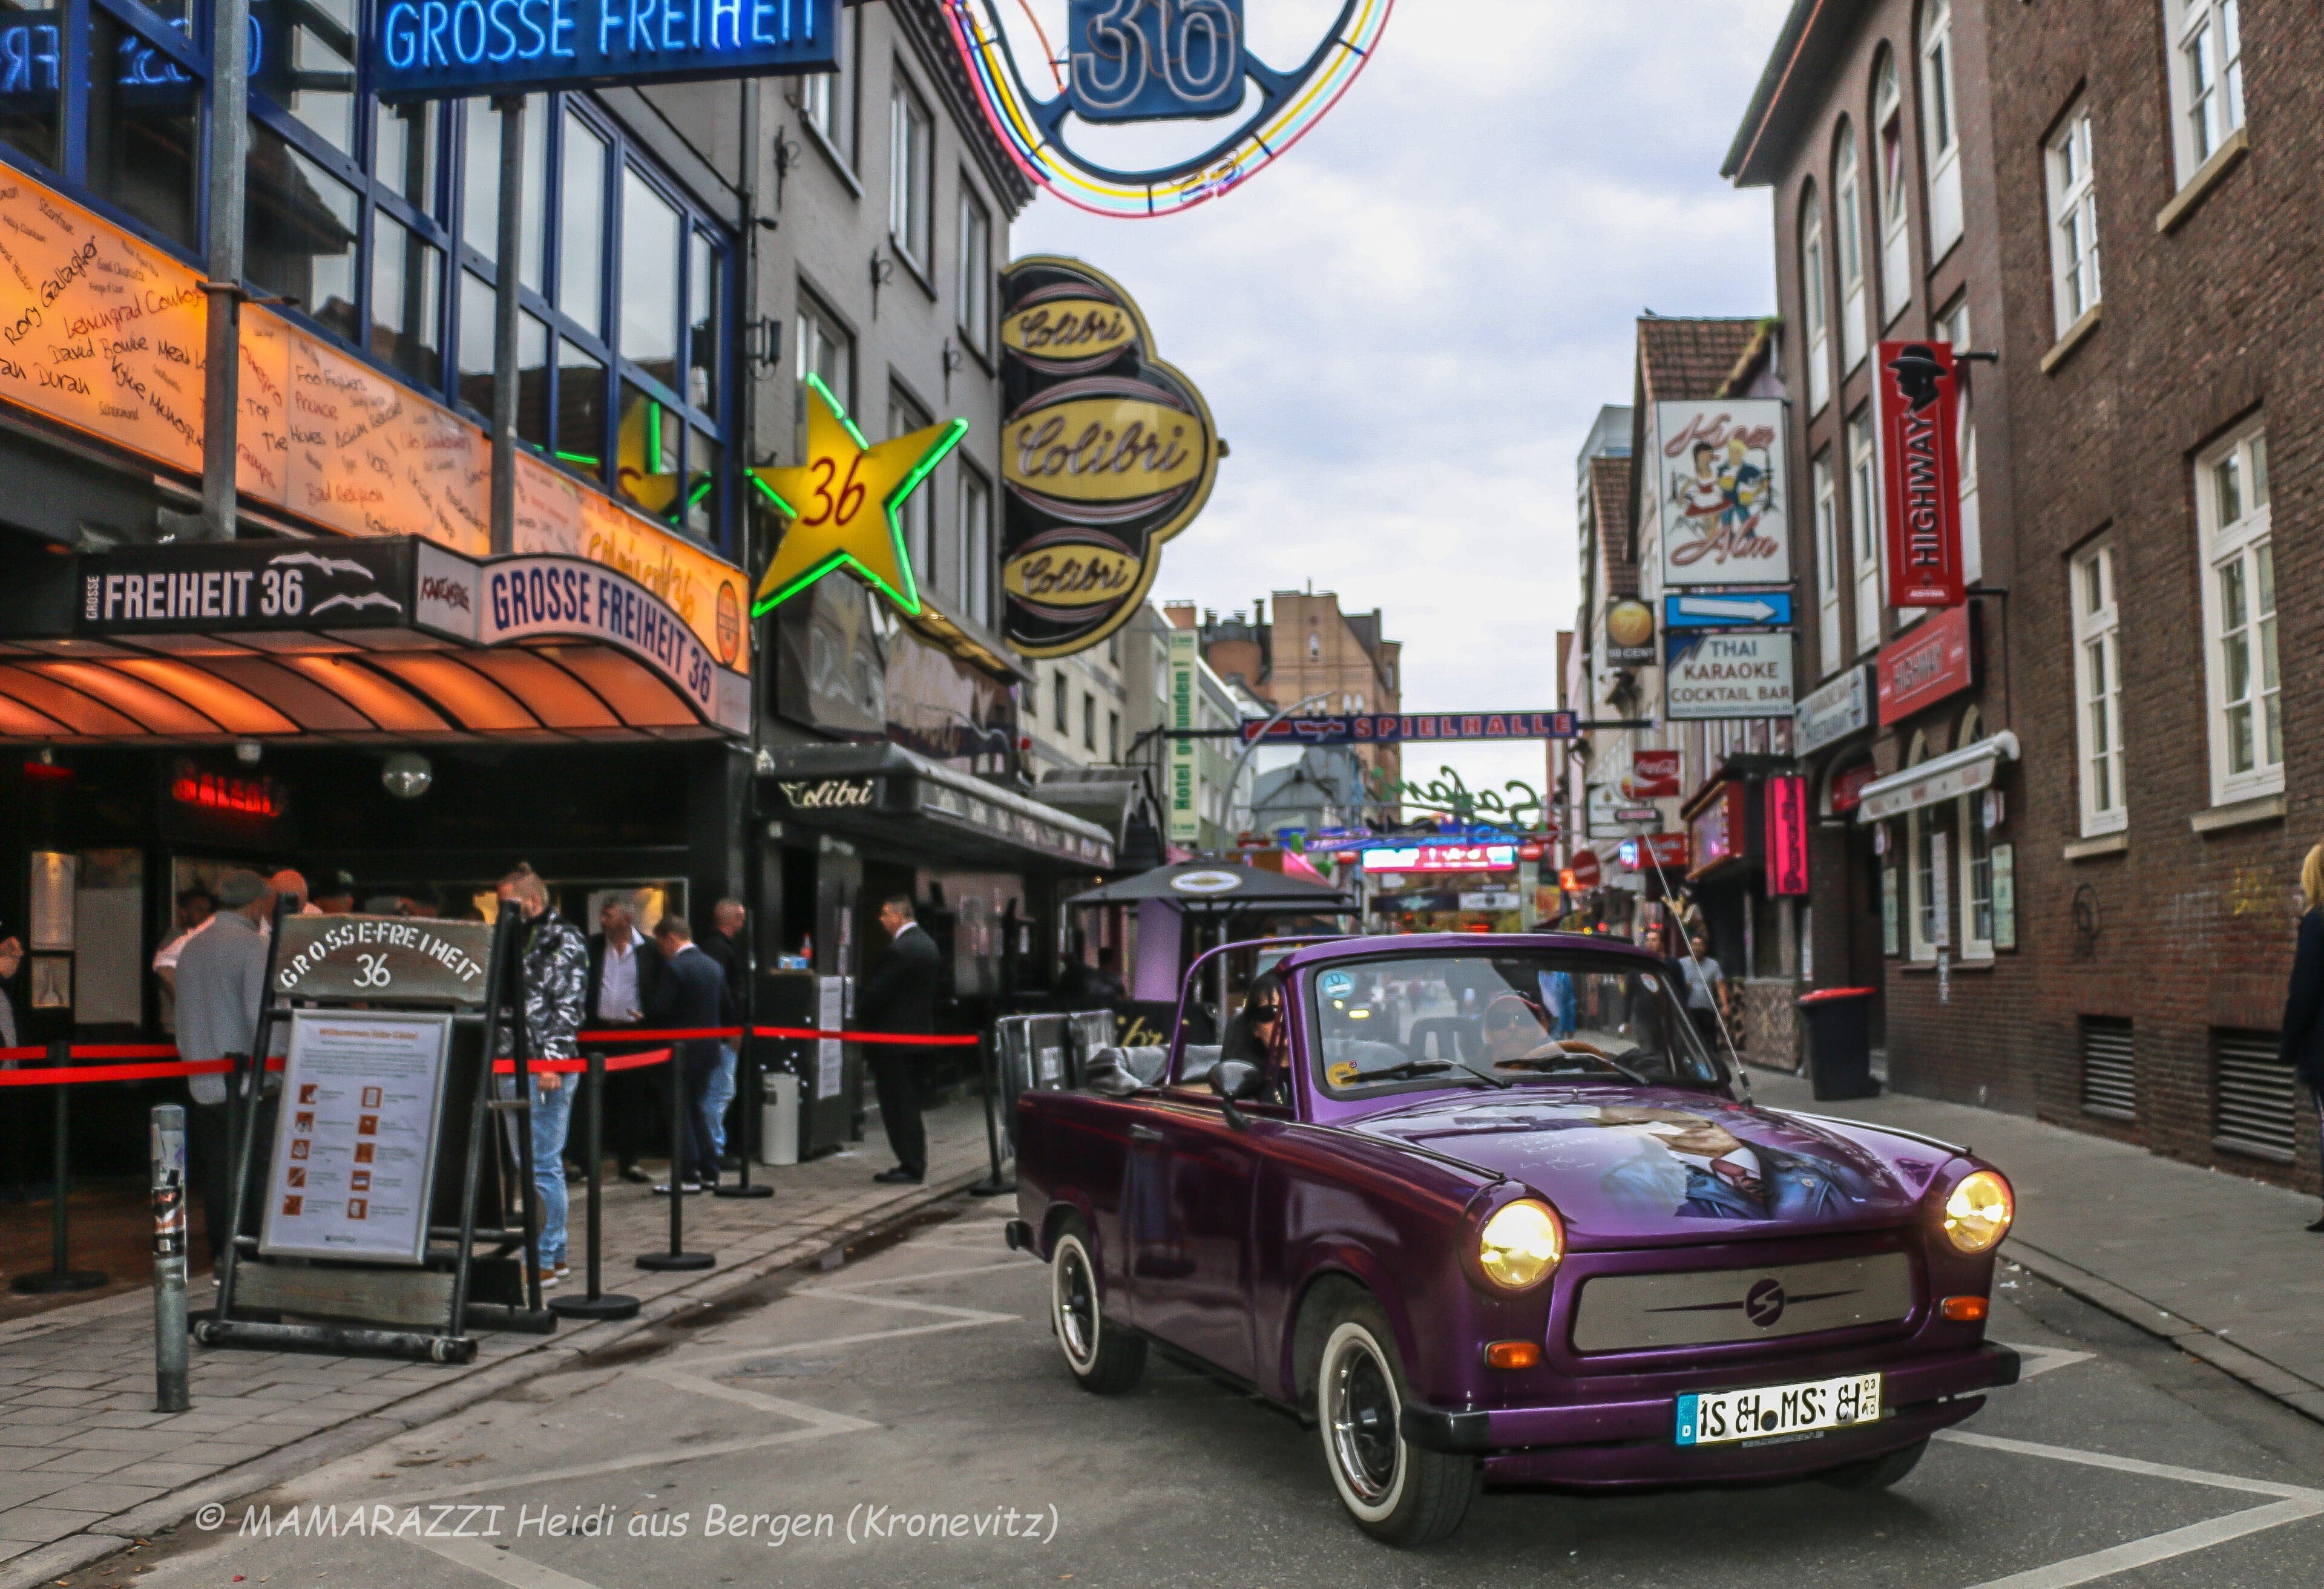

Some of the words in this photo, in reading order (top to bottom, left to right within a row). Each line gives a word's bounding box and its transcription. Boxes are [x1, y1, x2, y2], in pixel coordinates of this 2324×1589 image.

[386, 0, 576, 68] GROSSE
[599, 0, 814, 54] FREIHEIT
[1071, 0, 1235, 110] 36
[1020, 309, 1125, 347] Colibri
[48, 338, 95, 364] David
[99, 336, 148, 359] Bowie
[33, 362, 90, 395] Duran
[1016, 414, 1187, 477] Colibri
[802, 451, 865, 527] 36
[1906, 413, 1939, 566] HIGHWAY
[105, 571, 254, 621] FREIHEIT
[260, 569, 303, 617] 36
[1022, 555, 1129, 595] Colibri
[85, 575, 100, 621] GROSSE
[491, 566, 590, 631] GROSSE
[599, 577, 688, 675] FREIHEIT
[689, 649, 712, 704] 36
[1709, 640, 1757, 658] THAI
[1684, 661, 1779, 680] KARAOKE
[1670, 687, 1753, 702] COCKTAIL
[1758, 686, 1790, 701] BAR
[1354, 713, 1574, 739] SPIELHALLE
[1173, 764, 1191, 810] Hotel
[353, 953, 391, 987] 36
[1682, 1425, 1691, 1437] D
